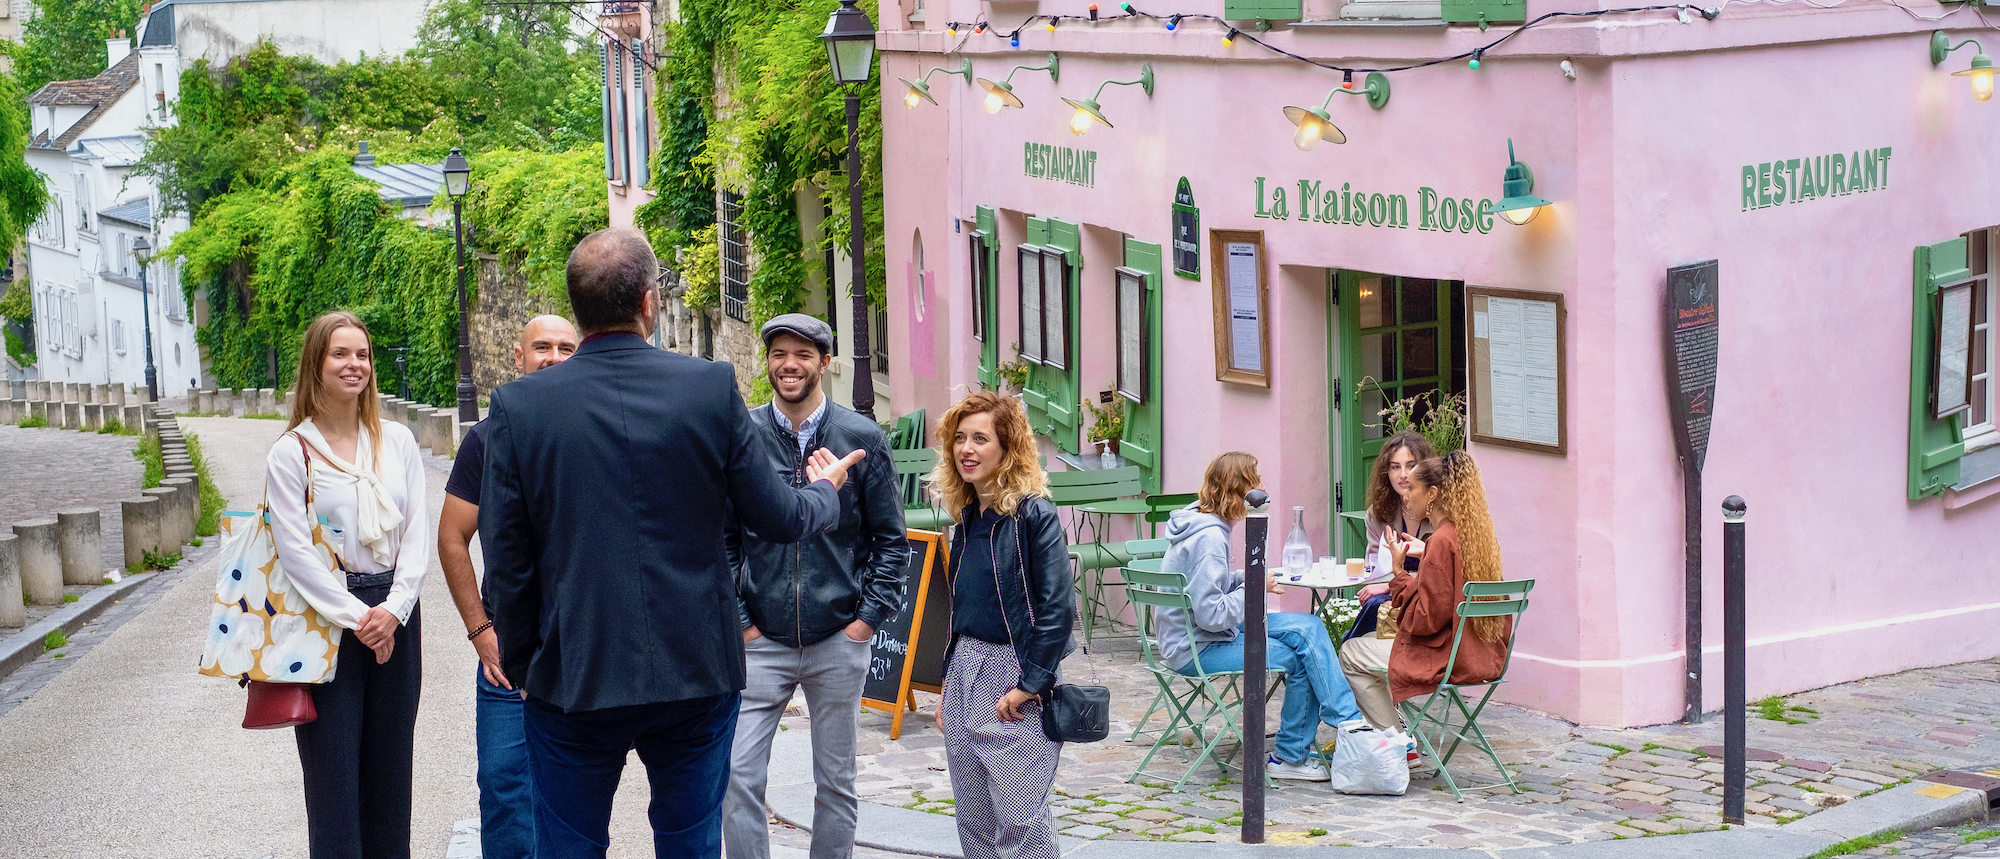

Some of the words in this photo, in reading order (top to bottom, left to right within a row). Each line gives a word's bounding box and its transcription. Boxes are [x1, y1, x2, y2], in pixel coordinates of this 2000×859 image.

[1024, 141, 1097, 188] RESTAURANT
[1741, 146, 1892, 212] RESTAURANT
[1254, 176, 1289, 220] La
[1297, 179, 1409, 229] Maison
[1417, 186, 1495, 235] Rose
